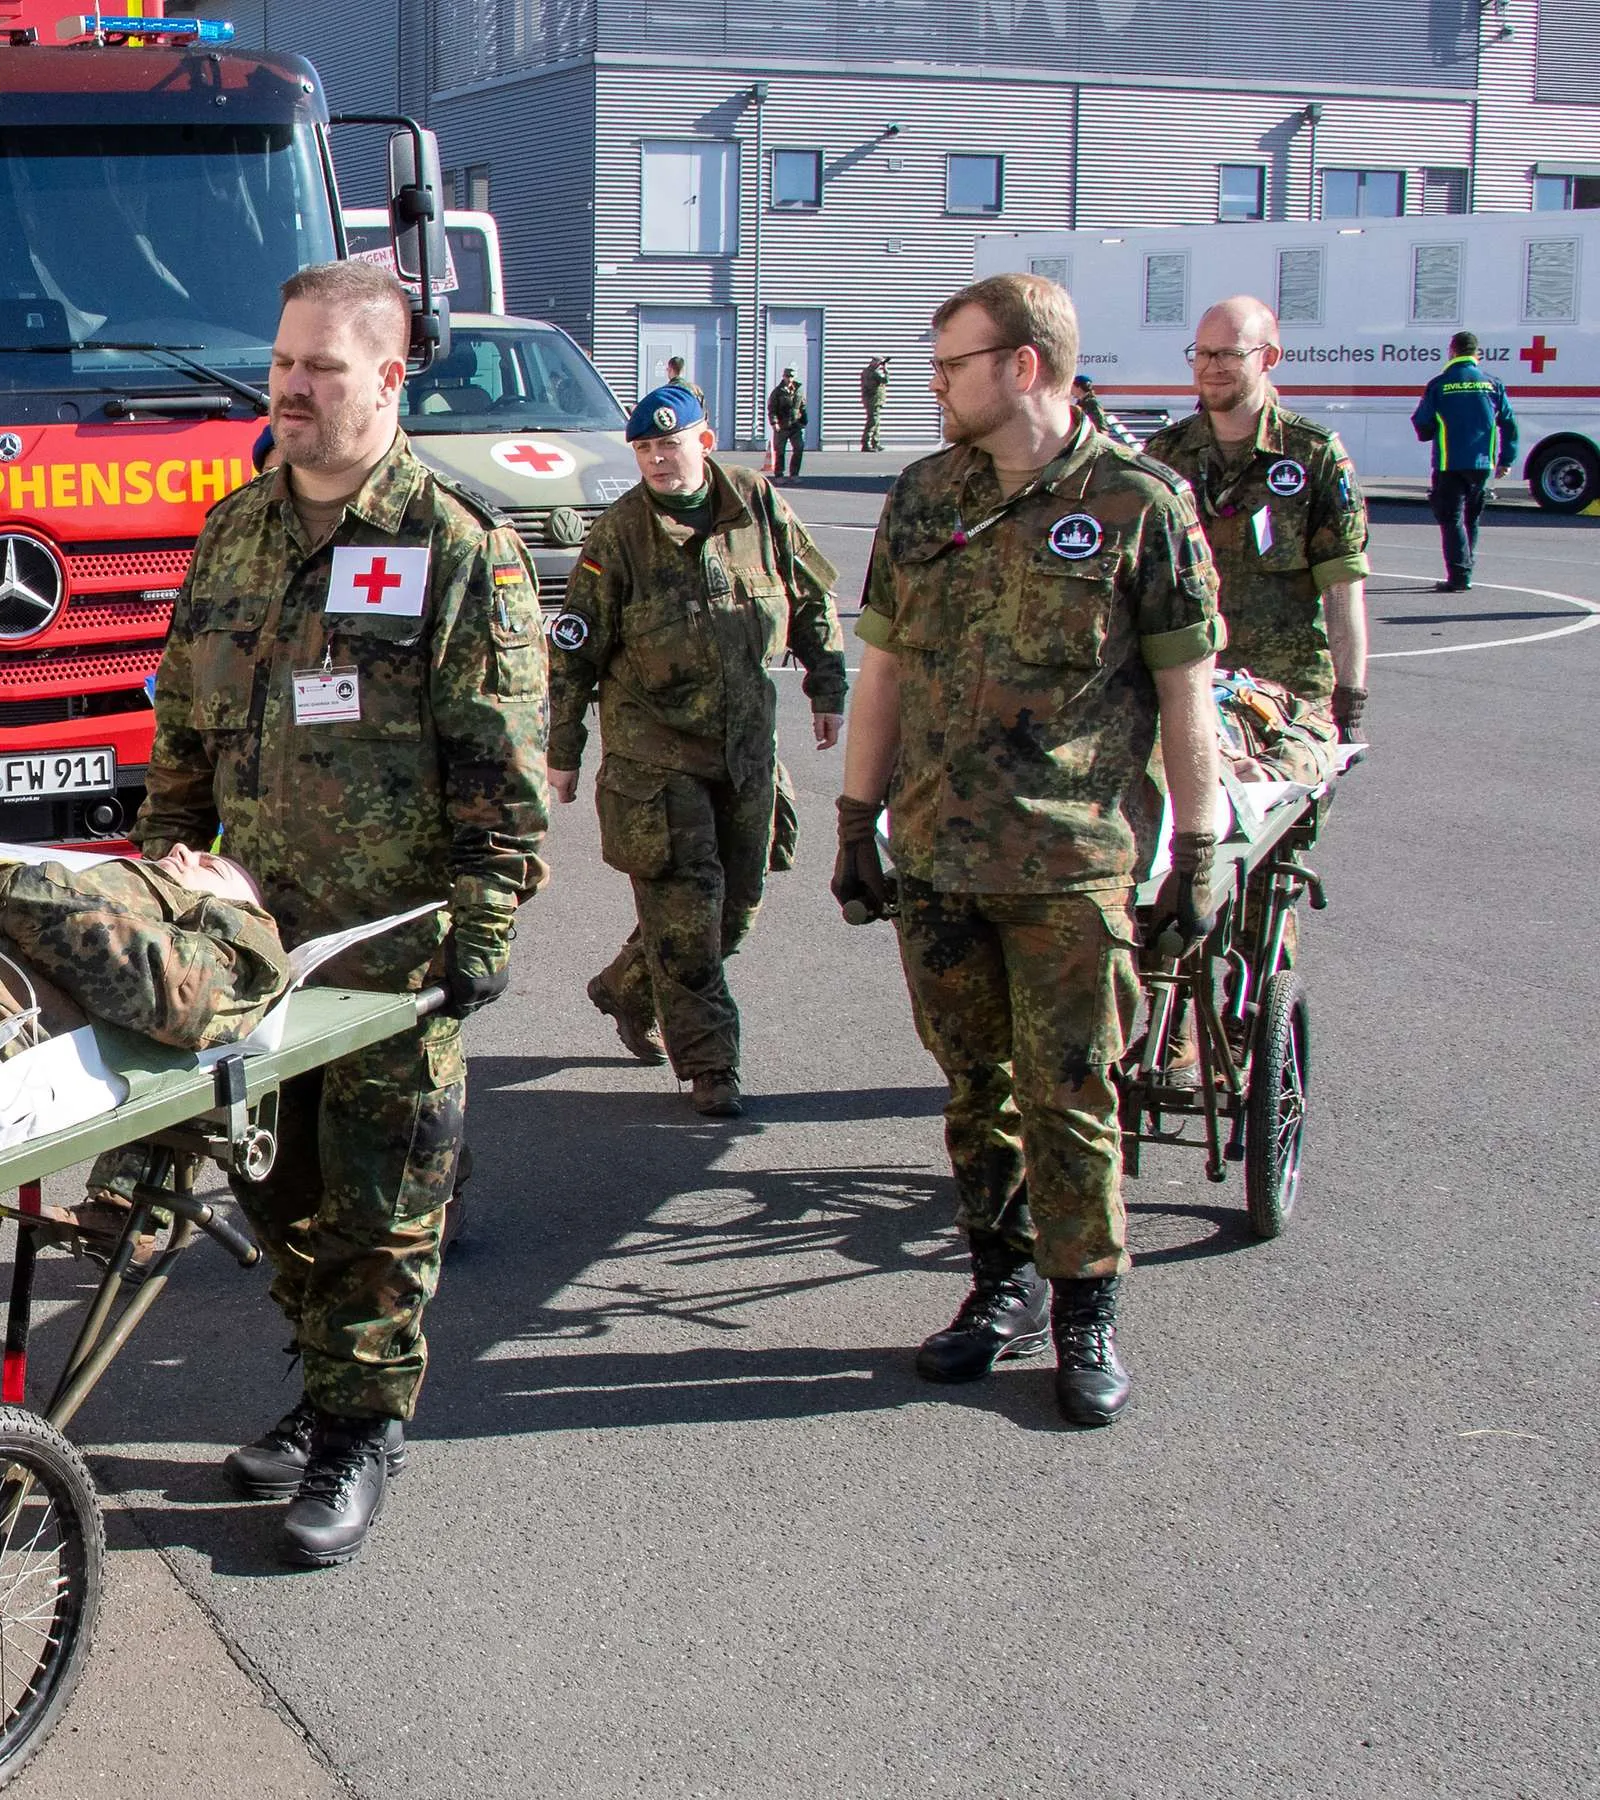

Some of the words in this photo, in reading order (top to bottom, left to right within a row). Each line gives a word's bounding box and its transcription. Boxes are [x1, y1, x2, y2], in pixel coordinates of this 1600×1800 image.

[1076, 352, 1119, 366] tpraxis
[1382, 344, 1441, 362] Rotes
[1477, 347, 1511, 361] euz
[6, 760, 45, 792] FW
[54, 755, 111, 788] 911
